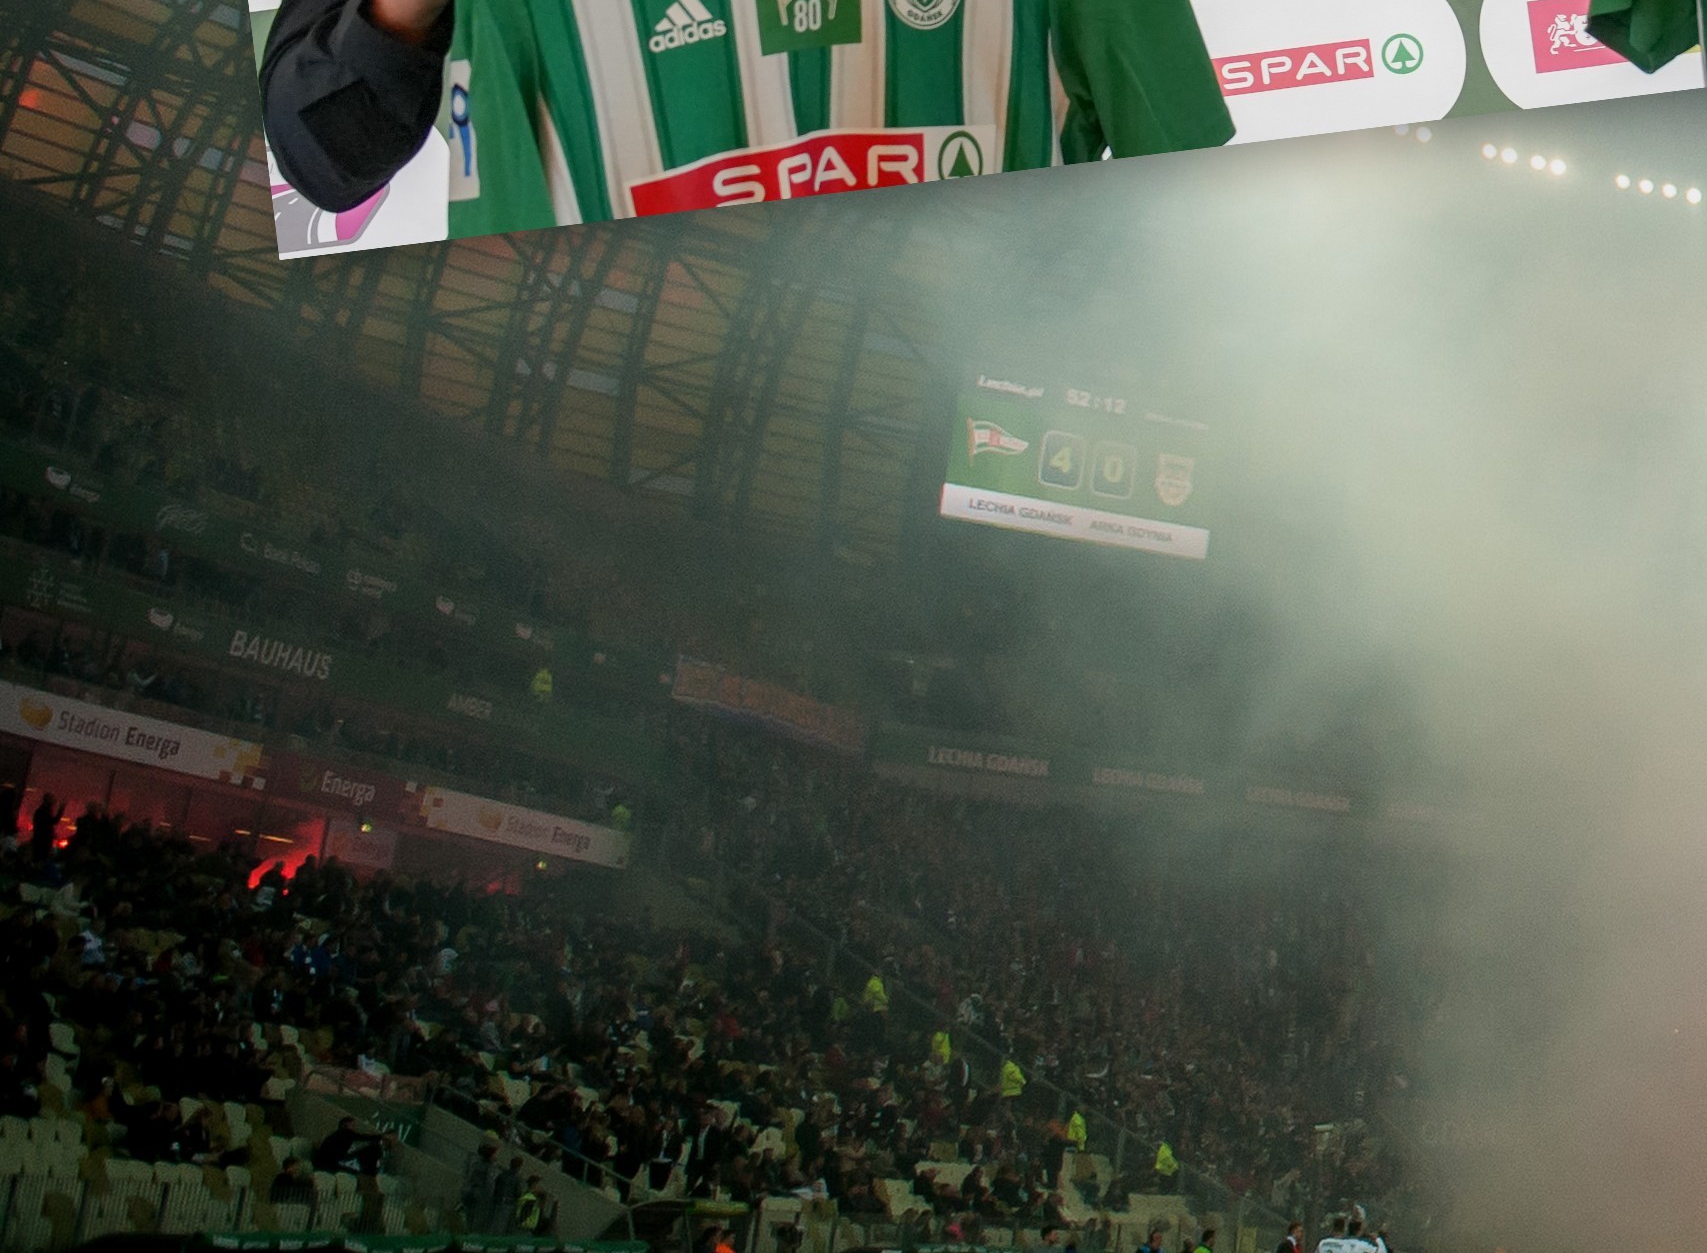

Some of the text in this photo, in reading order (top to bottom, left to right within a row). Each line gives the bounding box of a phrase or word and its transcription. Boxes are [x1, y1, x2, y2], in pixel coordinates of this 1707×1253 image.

[650, 19, 727, 53] adidas
[1222, 45, 1370, 90] SPAR
[713, 145, 920, 207] SPAR
[1049, 447, 1073, 474] 4
[1103, 455, 1125, 483] 0
[969, 498, 1016, 516] LECHIA
[228, 630, 333, 681] BAUHAUS
[58, 710, 182, 760] Stadion Energa
[320, 769, 377, 807] Energa
